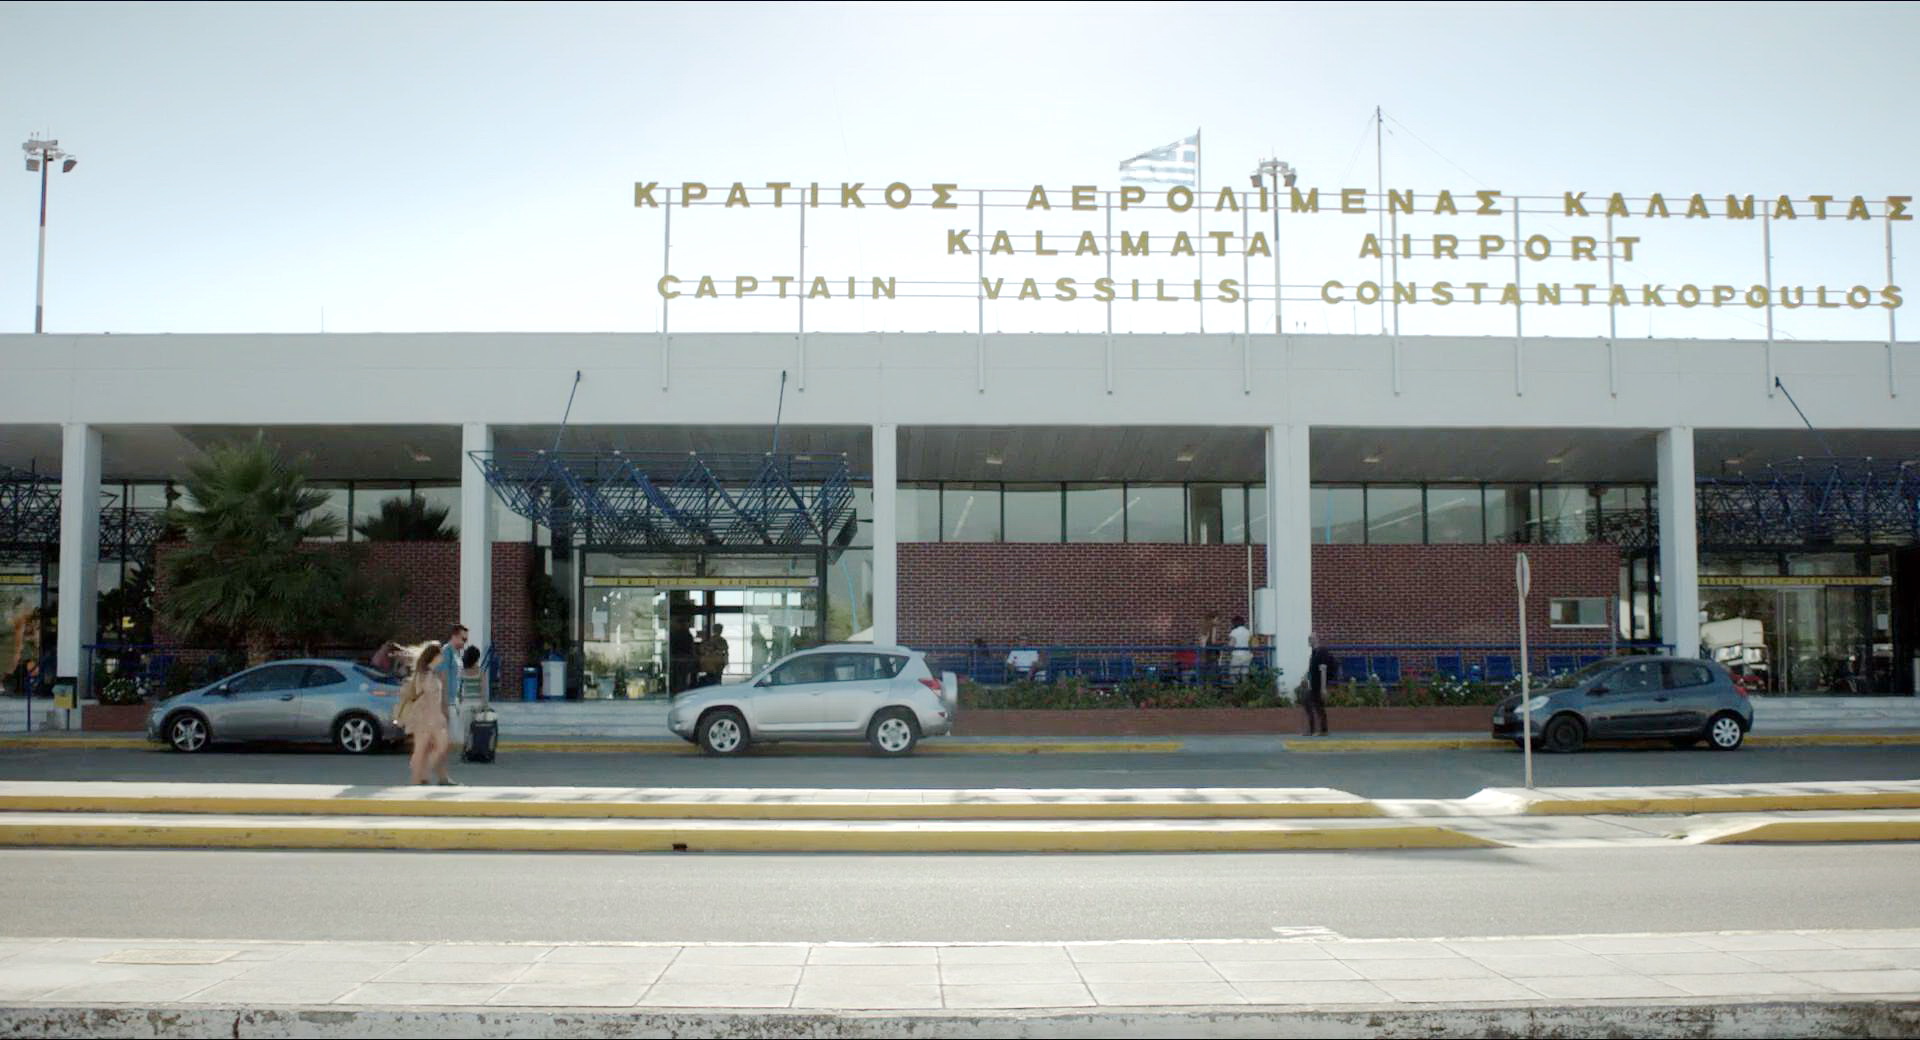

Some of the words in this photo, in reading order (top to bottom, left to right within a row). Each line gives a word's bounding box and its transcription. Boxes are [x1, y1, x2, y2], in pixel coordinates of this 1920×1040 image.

[634, 181, 958, 209] ΚΡΑΤΙΚΟΣ
[1026, 184, 1502, 215] ΑΕΡΟΛΙΜΕΝΑΣ
[1564, 191, 1914, 220] ΚΑΛΑΜΑΤΑΣ
[948, 229, 1275, 257] KALAMATA
[1359, 233, 1640, 261] AIRPORT
[657, 275, 896, 300] CAPTAIN
[981, 277, 1241, 302] VASSILIS
[1321, 280, 1904, 309] CONSTANTAKOPOULOS
